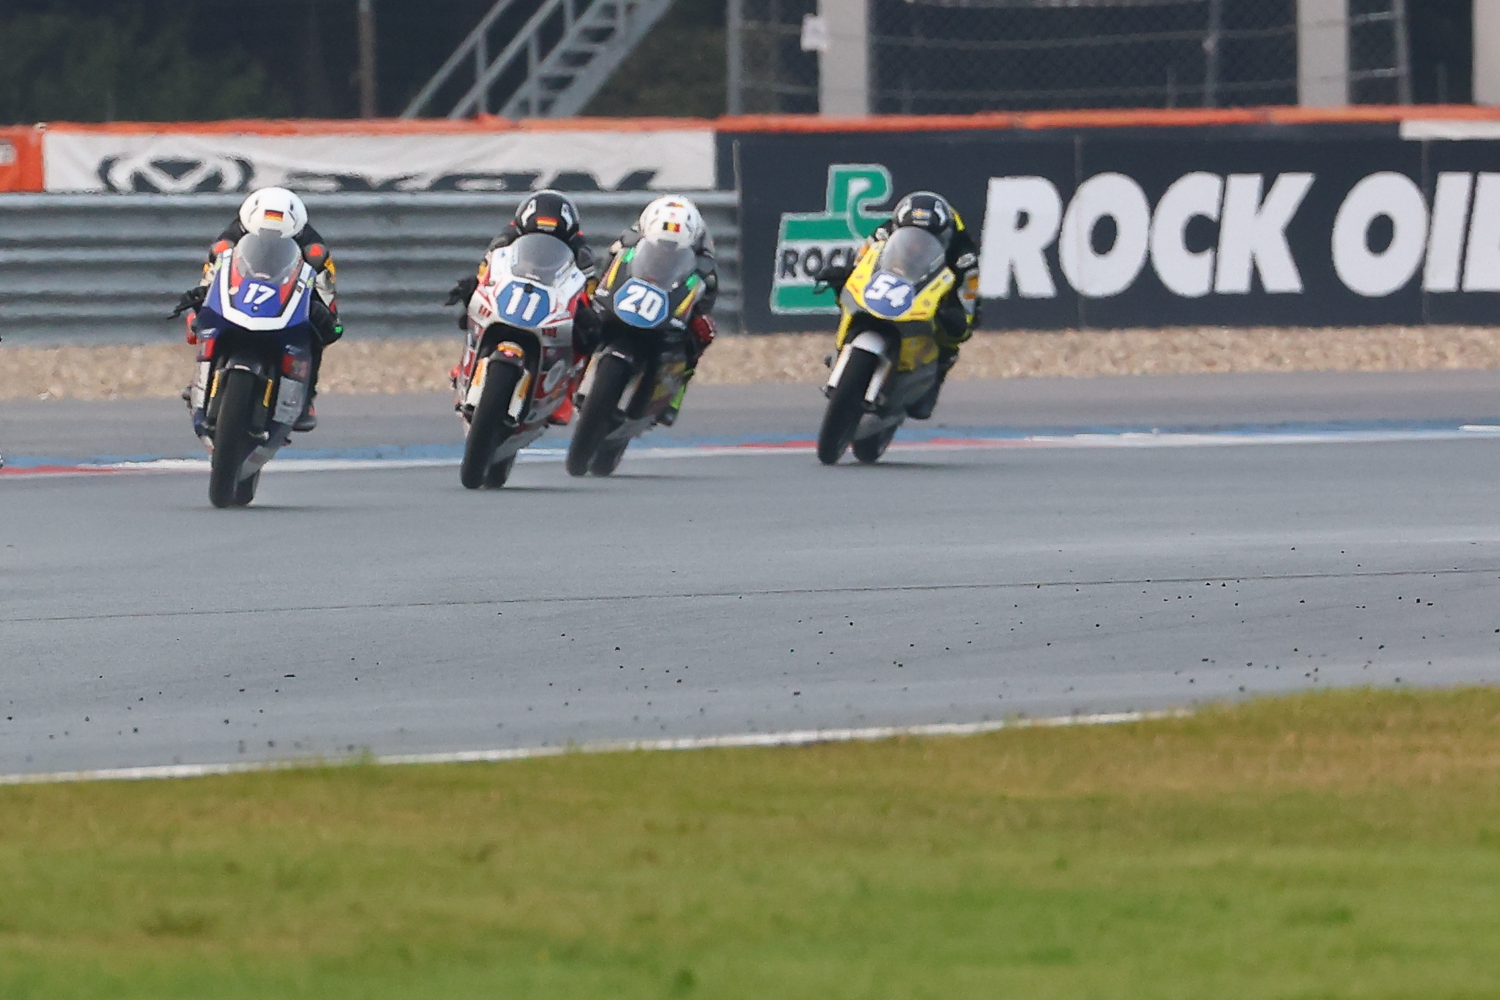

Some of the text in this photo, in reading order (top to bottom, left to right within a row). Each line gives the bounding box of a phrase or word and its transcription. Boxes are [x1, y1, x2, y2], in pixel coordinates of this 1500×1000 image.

[979, 170, 1500, 299] ROCK OIL
[781, 247, 854, 278] ROC
[243, 282, 277, 305] 17
[505, 286, 542, 321] 11
[617, 284, 664, 322] 20
[864, 273, 911, 308] 54
